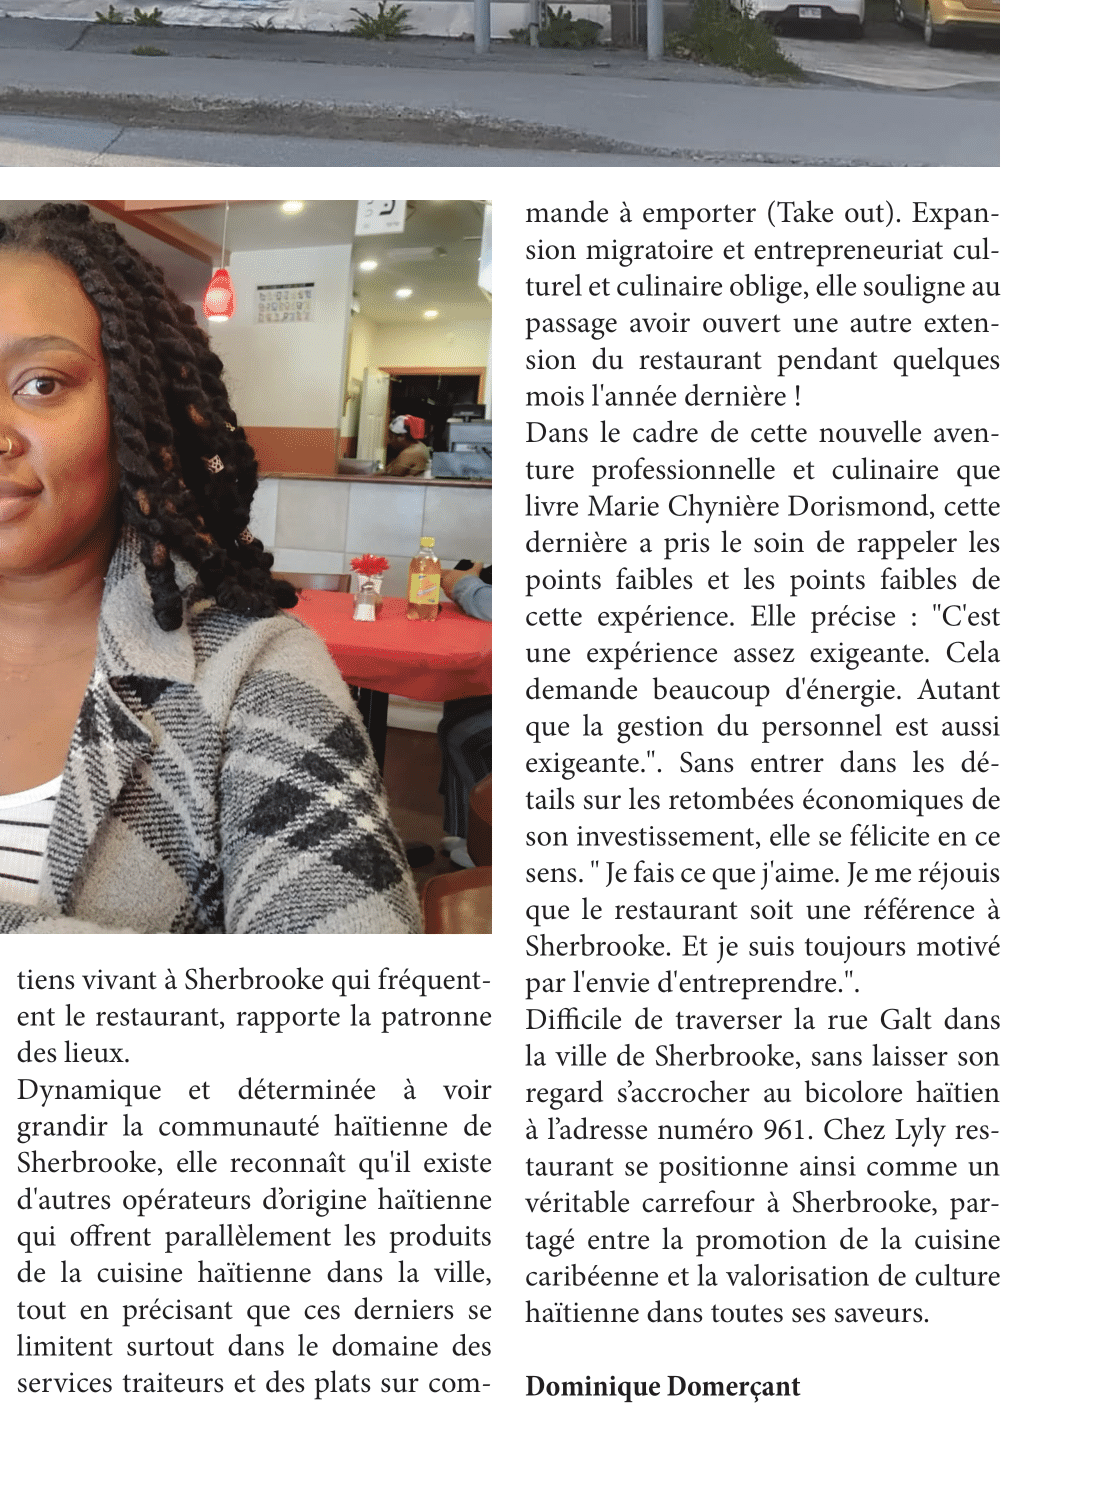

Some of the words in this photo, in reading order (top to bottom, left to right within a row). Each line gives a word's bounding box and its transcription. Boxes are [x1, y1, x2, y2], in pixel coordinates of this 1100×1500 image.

[526, 200, 608, 222] mande
[620, 201, 632, 222] à
[643, 205, 756, 229] emporter
[768, 200, 833, 227] (Take
[845, 200, 900, 227] out).
[912, 202, 999, 229] Expan-
[526, 494, 578, 516] livre
[588, 496, 659, 516] Marie
[669, 494, 779, 523] Chynière
[788, 494, 934, 519] Dorismond,
[945, 498, 1000, 516] cette
[526, 787, 574, 809] tails
[584, 795, 621, 809] sur
[629, 787, 660, 809] les
[669, 787, 793, 809] retombées
[803, 788, 963, 816] économiques
[973, 787, 1000, 809] de
[526, 1007, 621, 1029] Difficile
[635, 1007, 662, 1029] de
[676, 1012, 782, 1029] traverser
[794, 1007, 815, 1029] la
[828, 1015, 867, 1029] rue
[881, 1007, 932, 1030] Galt
[945, 1007, 1000, 1029] dans
[17, 1079, 161, 1107] Dynamique
[189, 1082, 210, 1099] et
[239, 1077, 375, 1099] déterminée
[404, 1078, 416, 1099] à
[443, 1079, 491, 1099] voir
[526, 1118, 538, 1139] à
[548, 1117, 647, 1139] l’adresse
[658, 1118, 753, 1139] numéro
[764, 1120, 812, 1139] 961.
[824, 1117, 885, 1140] Chez
[896, 1117, 946, 1147] Lyly
[955, 1125, 999, 1139] res-
[18, 1226, 55, 1253] qui
[71, 1224, 151, 1246] offrent
[165, 1224, 331, 1253] parallèlement
[345, 1224, 375, 1246] les
[389, 1224, 491, 1253] produits
[17, 1334, 112, 1356] limitent
[127, 1338, 214, 1356] surtout
[229, 1334, 284, 1356] dans
[298, 1334, 318, 1356] le
[333, 1334, 438, 1356] domaine
[453, 1334, 491, 1356] des
[526, 1376, 660, 1402] Dominique
[667, 1376, 800, 1402] Domerçant
